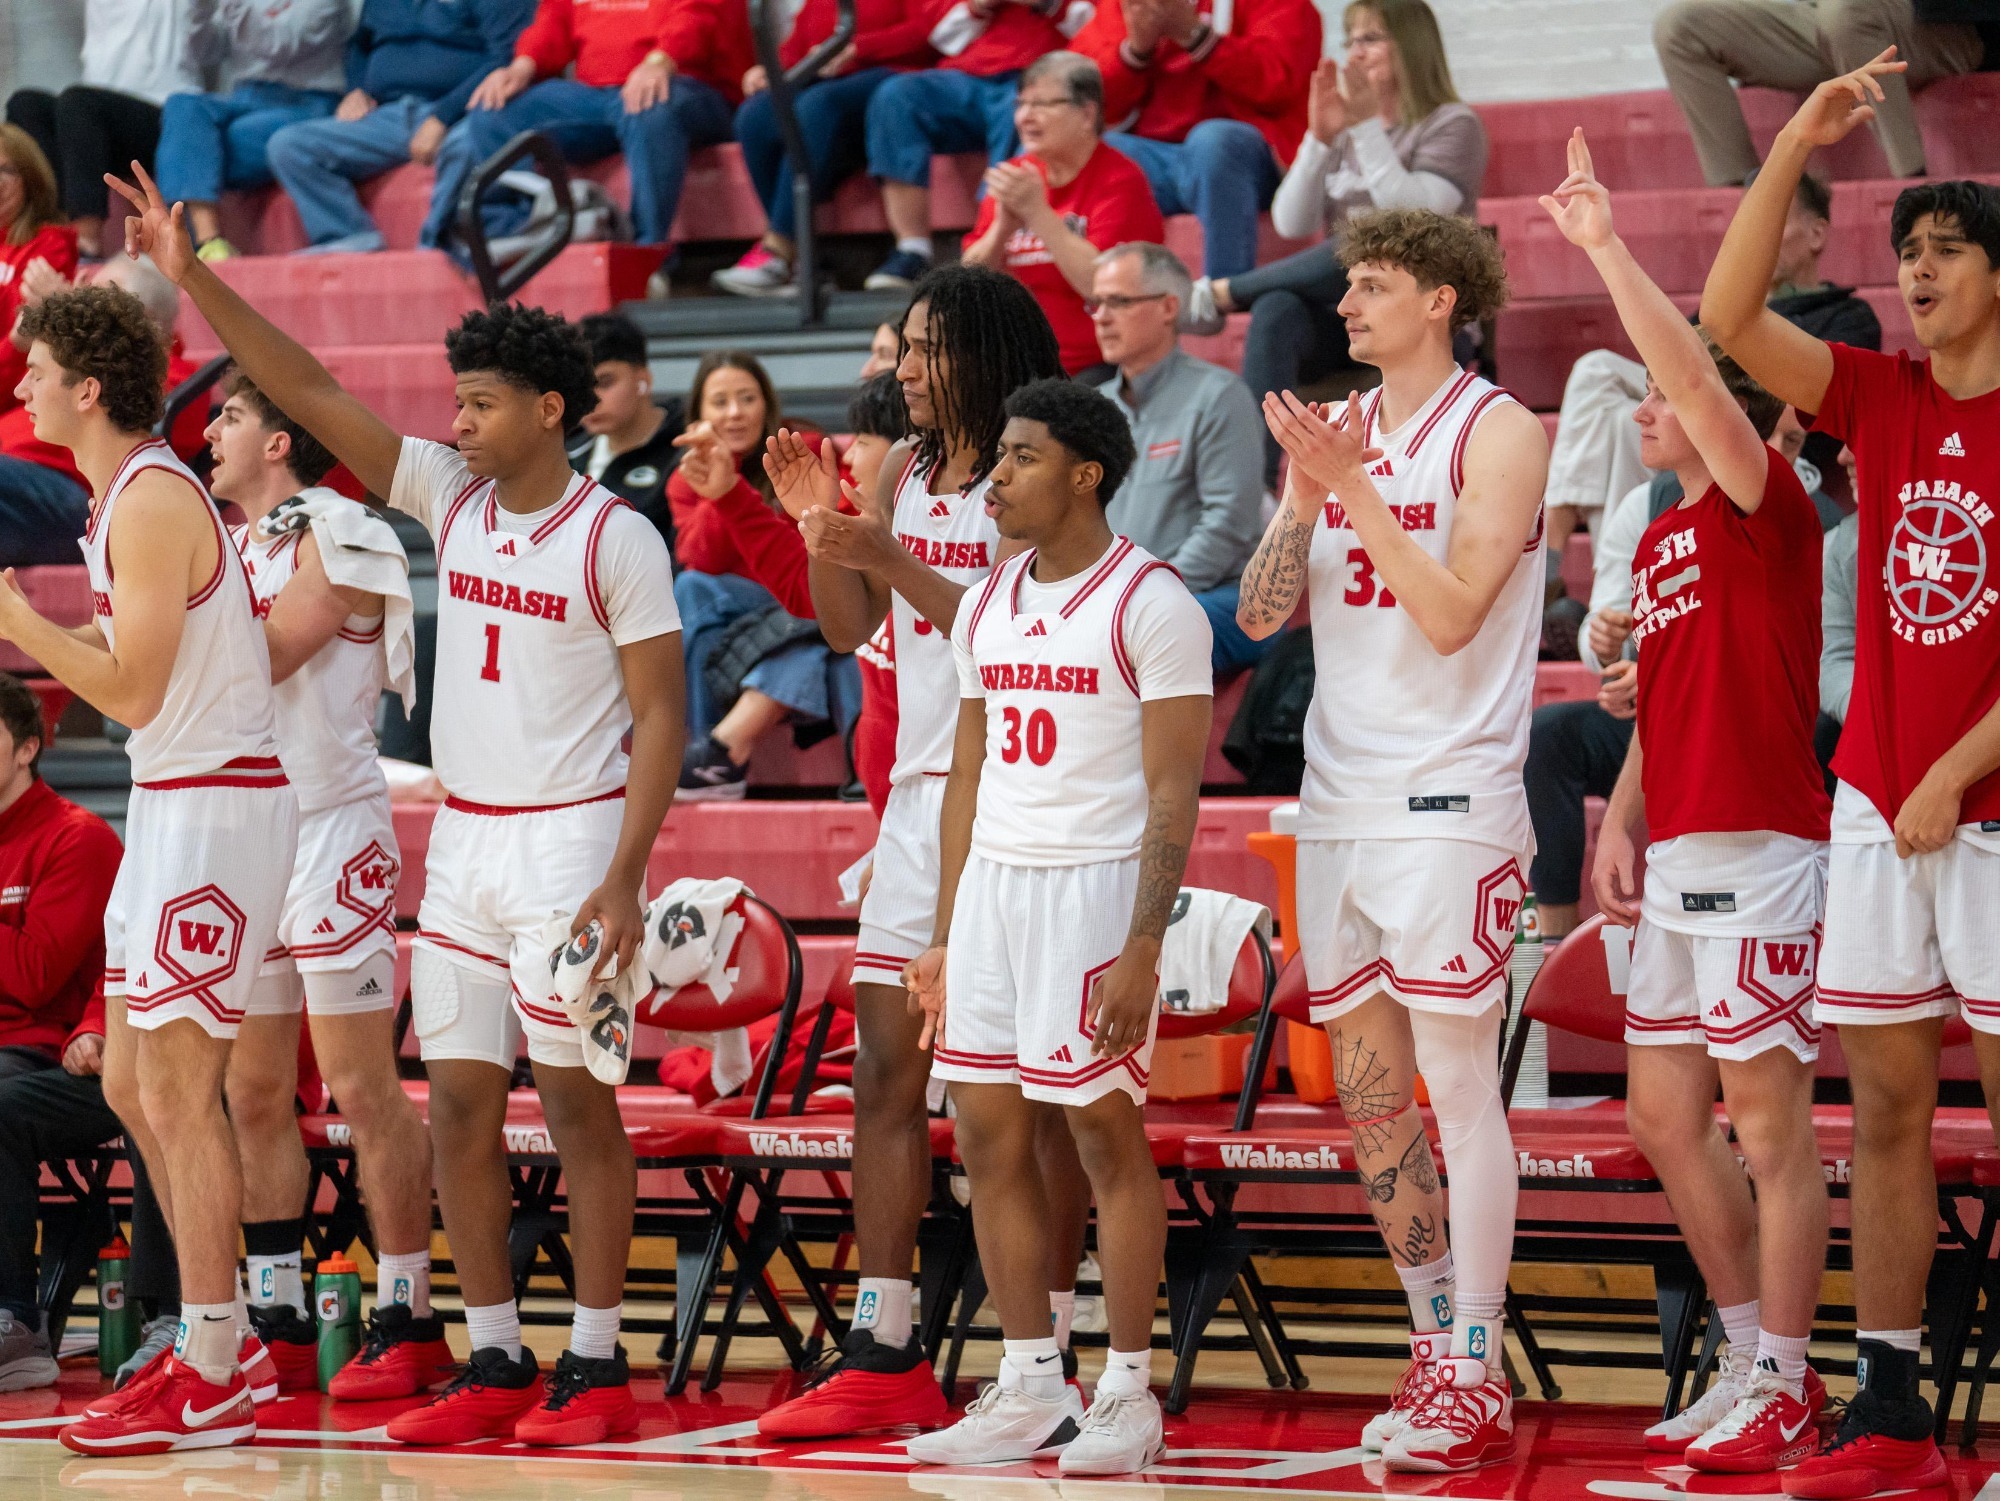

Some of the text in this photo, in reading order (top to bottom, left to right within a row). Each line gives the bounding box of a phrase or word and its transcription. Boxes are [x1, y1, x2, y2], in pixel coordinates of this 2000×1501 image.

[1344, 548, 1397, 608] 3
[448, 570, 569, 623] WABASH
[1921, 587, 2000, 646] GIANTS
[480, 623, 501, 683] 1
[979, 663, 1100, 695] WABASH
[1002, 706, 1057, 767] 30
[1494, 897, 1519, 932] W.
[178, 919, 226, 957] W.
[1763, 942, 1811, 976] W.
[749, 1133, 853, 1157] Wabash
[1219, 1145, 1341, 1170] Wabash
[1516, 1152, 1596, 1178] bash
